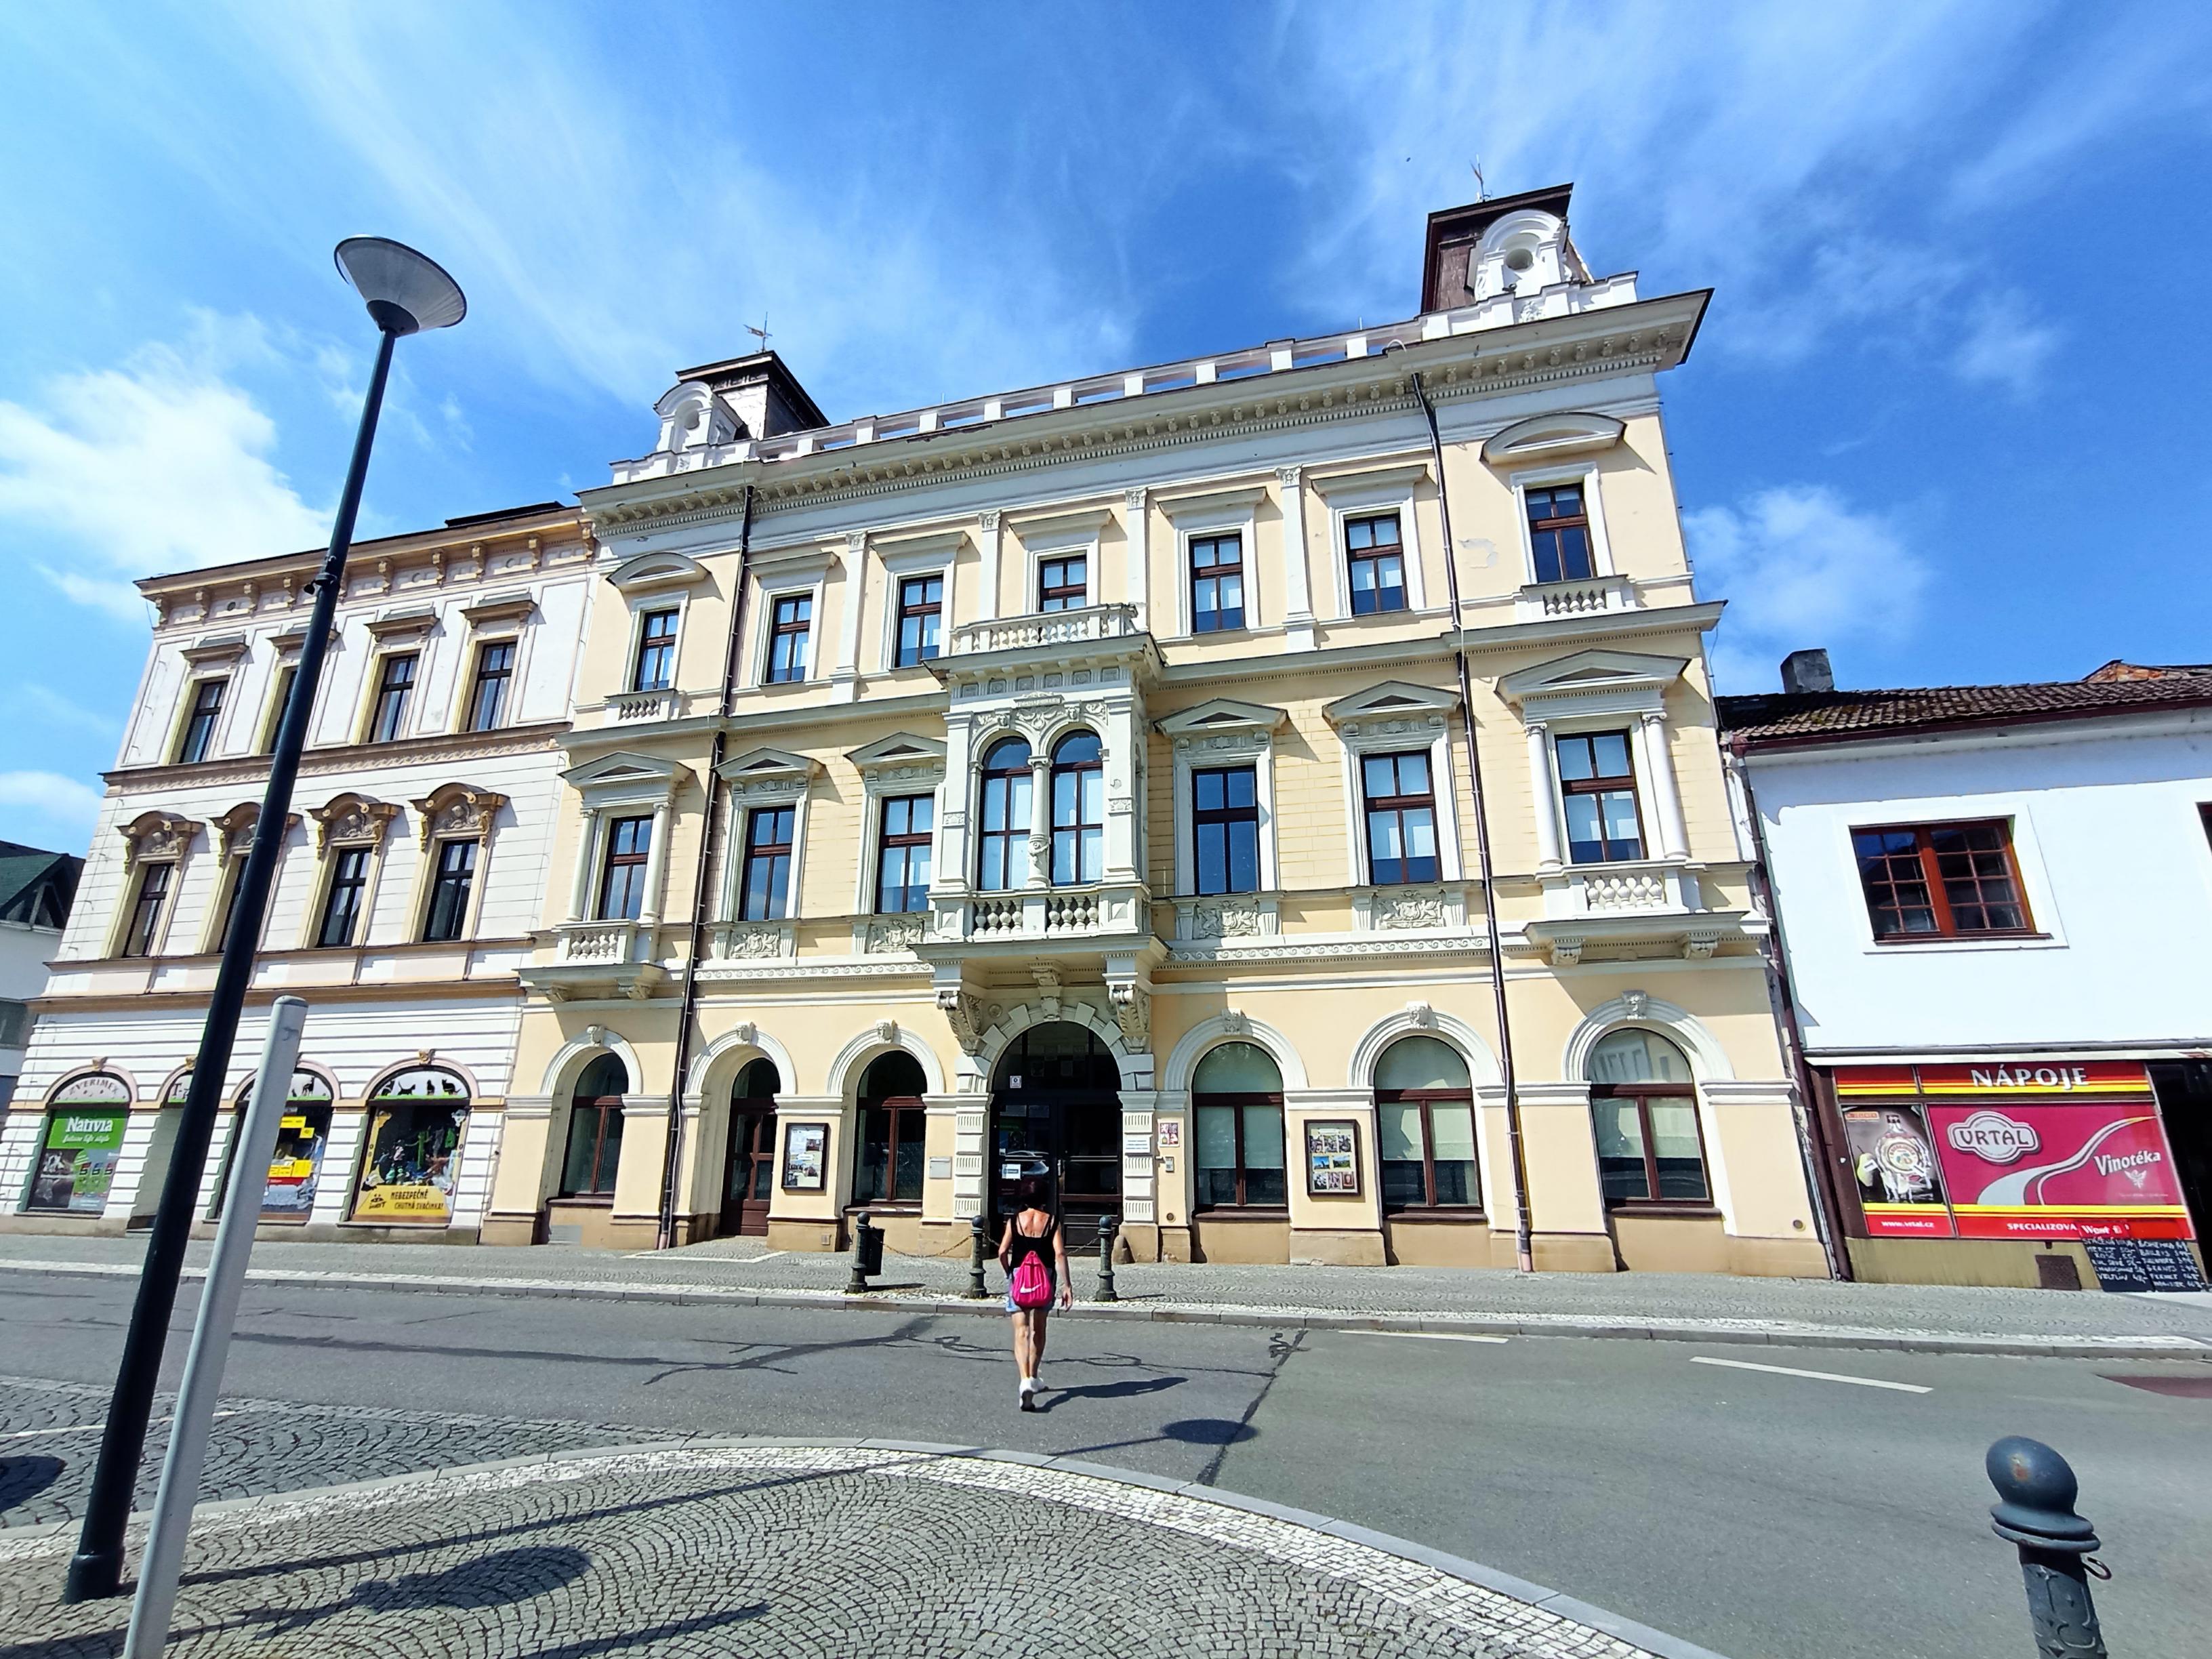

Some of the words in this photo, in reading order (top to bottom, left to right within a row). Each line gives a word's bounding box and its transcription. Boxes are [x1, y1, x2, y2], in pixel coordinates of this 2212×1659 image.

[1971, 1065, 2089, 1090] NÁPOJE
[1959, 1130, 2030, 1145] VRTAL
[2093, 1150, 2162, 1176] Vinotéka
